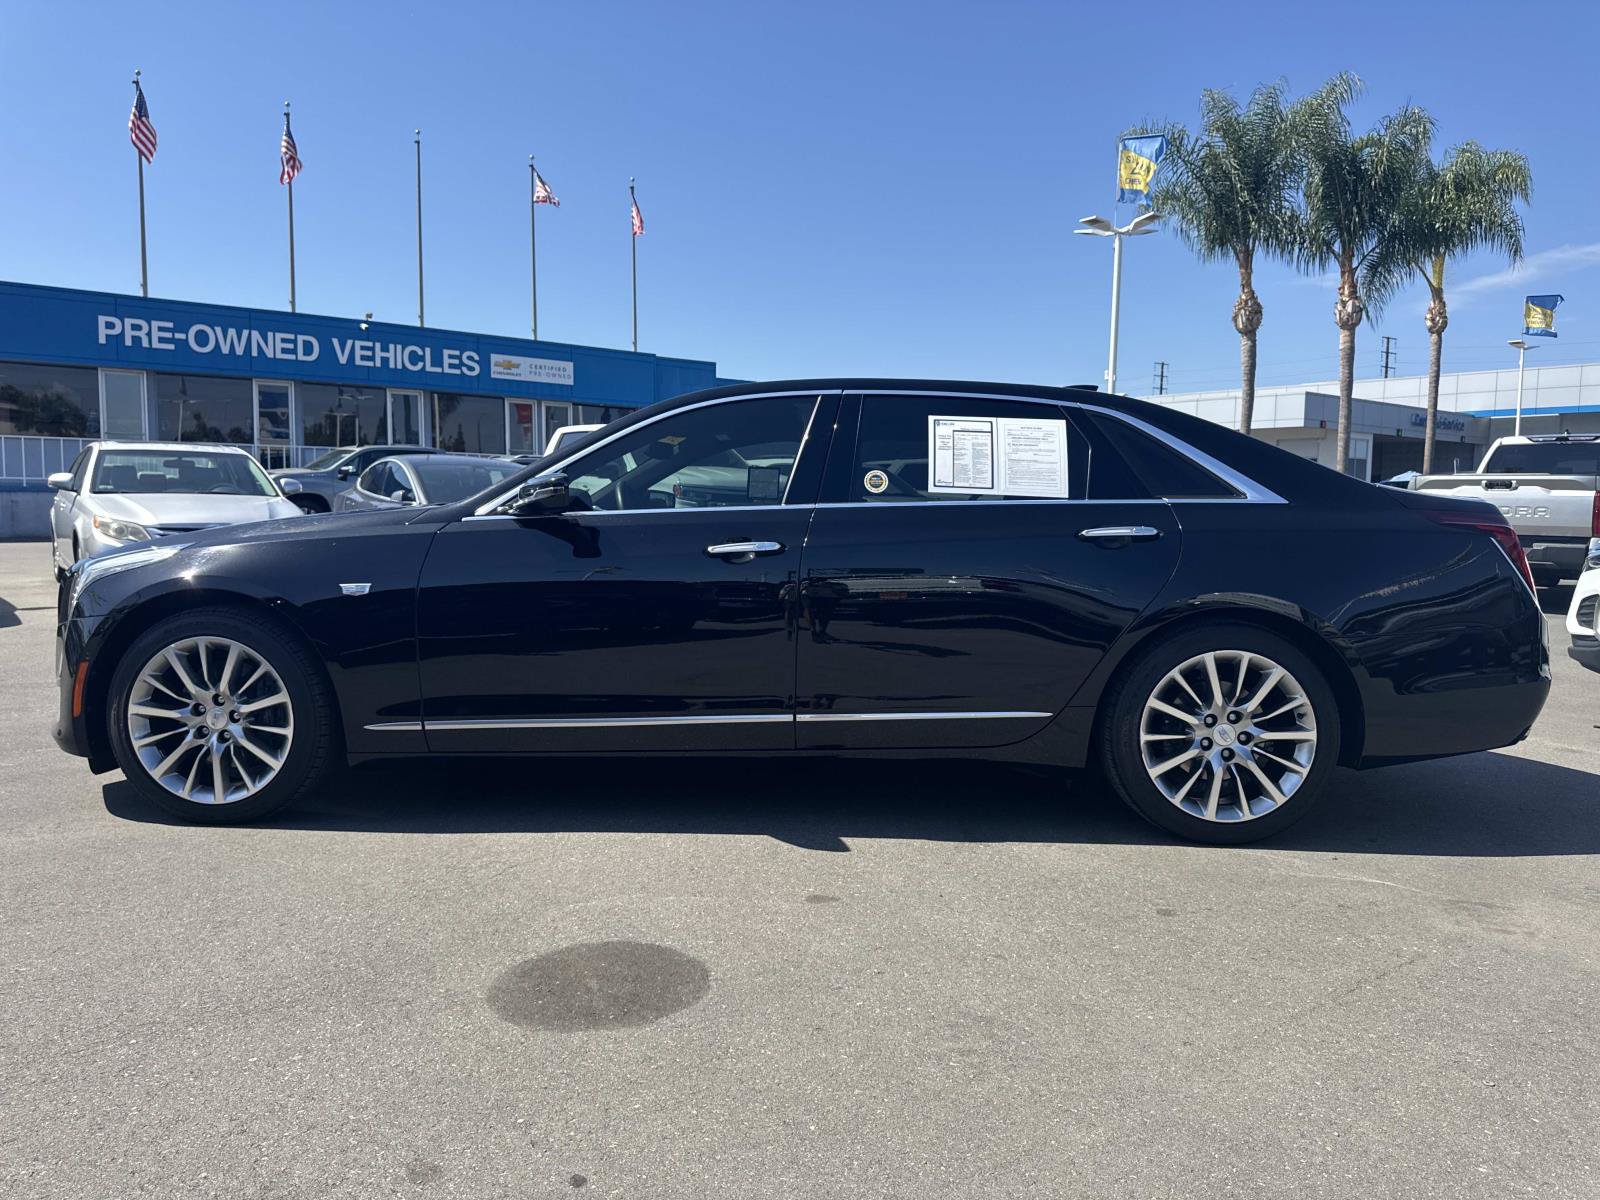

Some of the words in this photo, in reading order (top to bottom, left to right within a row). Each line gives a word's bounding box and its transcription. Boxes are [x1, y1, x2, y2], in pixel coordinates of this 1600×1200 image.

[97, 315, 320, 362] PRE-OWNED
[332, 337, 481, 377] VEHICLES
[529, 363, 567, 373] CERTIFIED
[529, 370, 572, 379] PRE-OWNED
[1500, 505, 1550, 518] DRA
